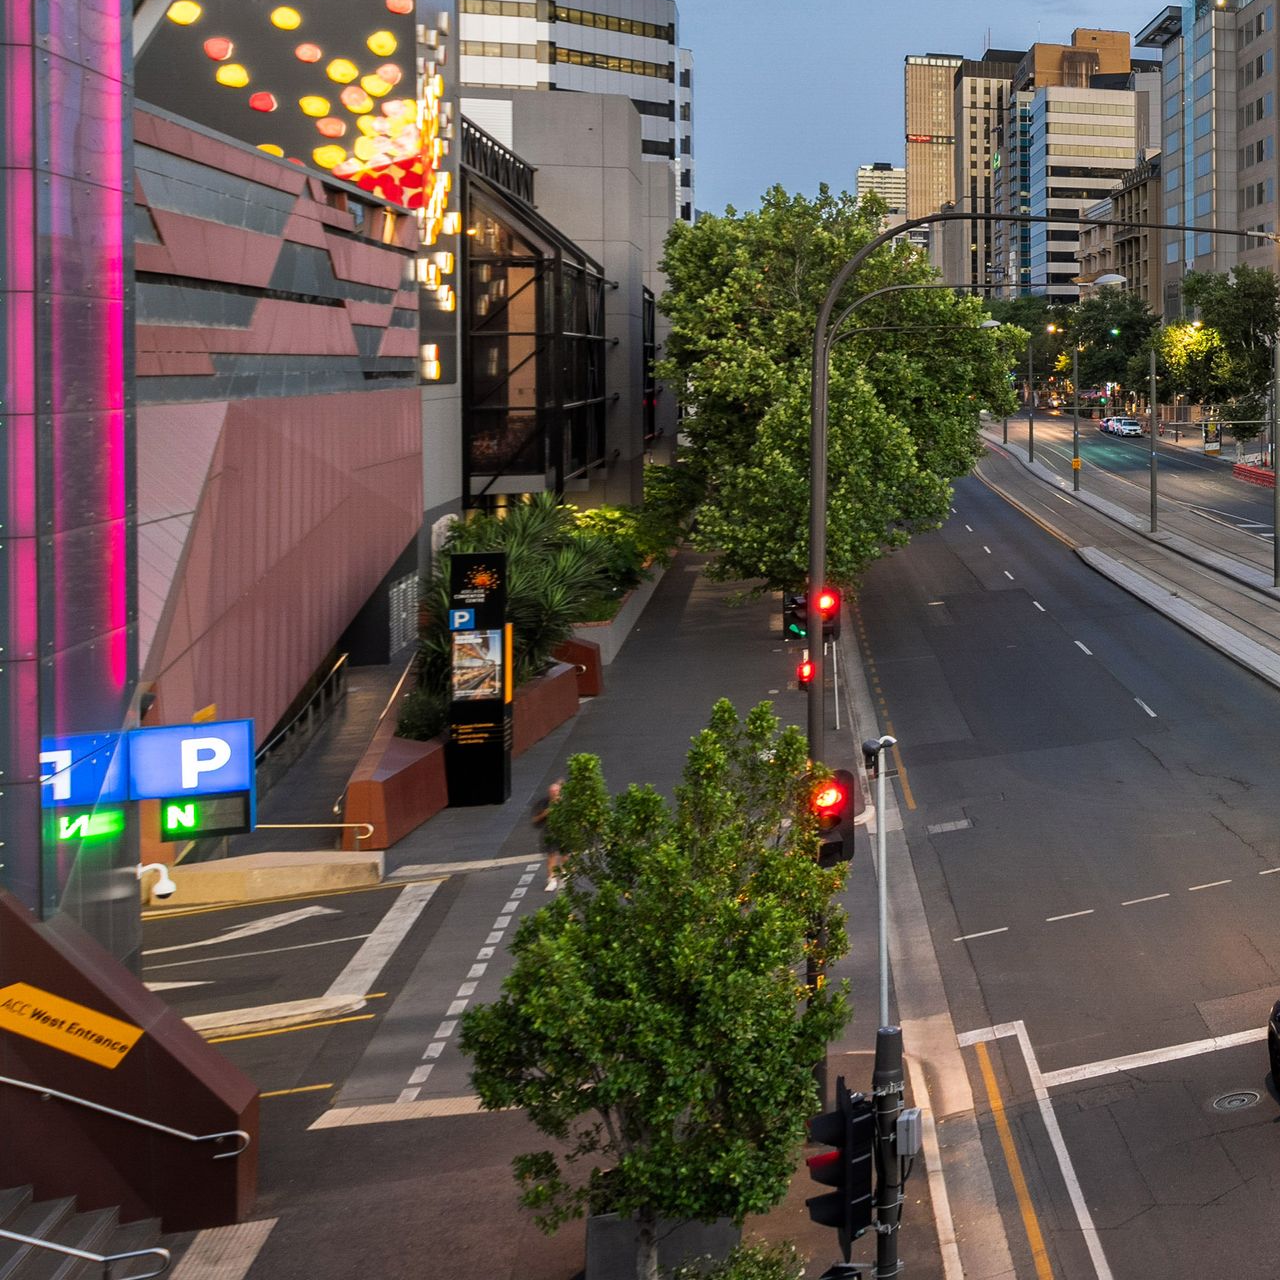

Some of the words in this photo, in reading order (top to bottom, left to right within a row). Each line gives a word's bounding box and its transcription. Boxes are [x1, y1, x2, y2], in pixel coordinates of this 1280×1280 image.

[454, 612, 470, 628] P
[181, 737, 231, 789] P
[1, 999, 31, 1016] ACC
[30, 1008, 65, 1030] West
[66, 1023, 129, 1054] Entrance
